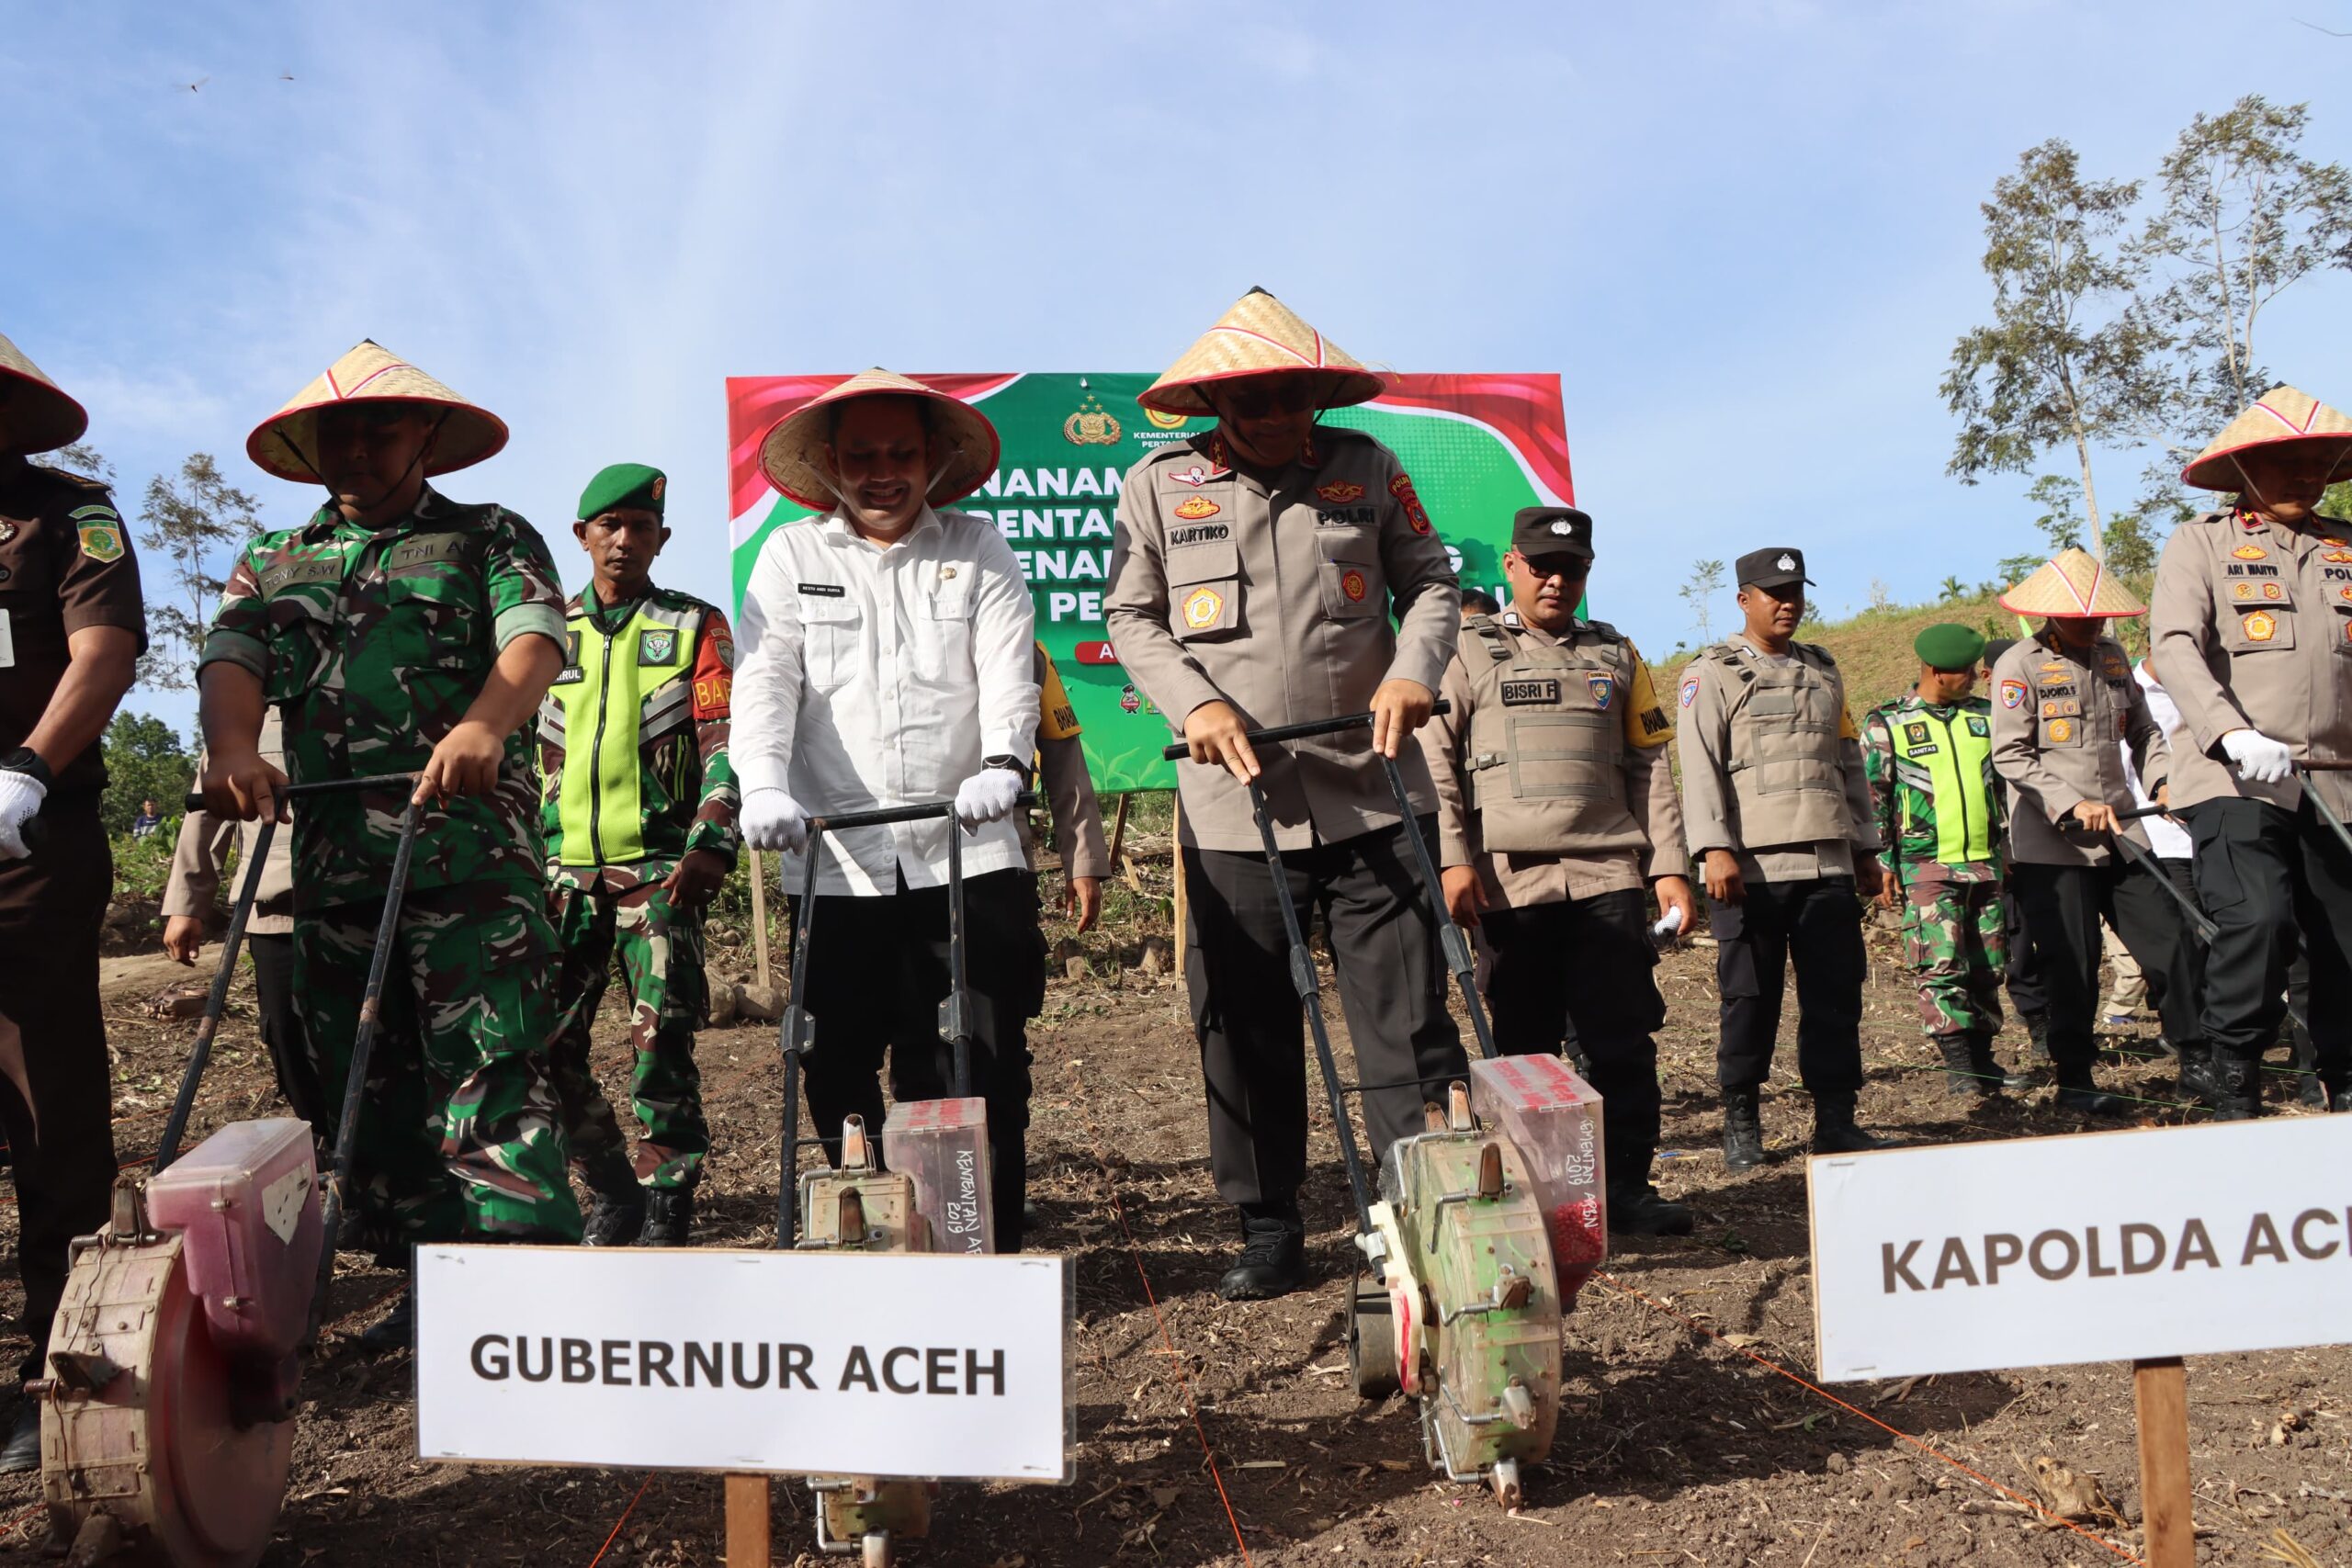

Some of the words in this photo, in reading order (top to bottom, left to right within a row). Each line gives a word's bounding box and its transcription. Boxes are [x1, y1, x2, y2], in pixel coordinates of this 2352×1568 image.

[1142, 440, 1175, 448] PERT
[967, 508, 1118, 538] ENTA
[1317, 507, 1375, 525] POLRI
[1170, 525, 1229, 546] KARTIKO
[401, 545, 434, 559] TNI
[1014, 549, 1113, 580] ENA
[2228, 564, 2244, 575] ARI
[2246, 564, 2278, 576] WAHYU
[265, 567, 300, 588] TONY
[1505, 684, 1542, 700] BISRI
[1545, 683, 1555, 698] F
[1908, 745, 1937, 756] SANITAS
[1566, 1154, 1583, 1186] 2019
[946, 1201, 965, 1234] 2019
[1881, 1217, 2222, 1295] KAPOLDA
[2240, 1205, 2352, 1266] AC
[469, 1333, 820, 1391] GUBERNUR
[837, 1344, 1007, 1396] ACEH
